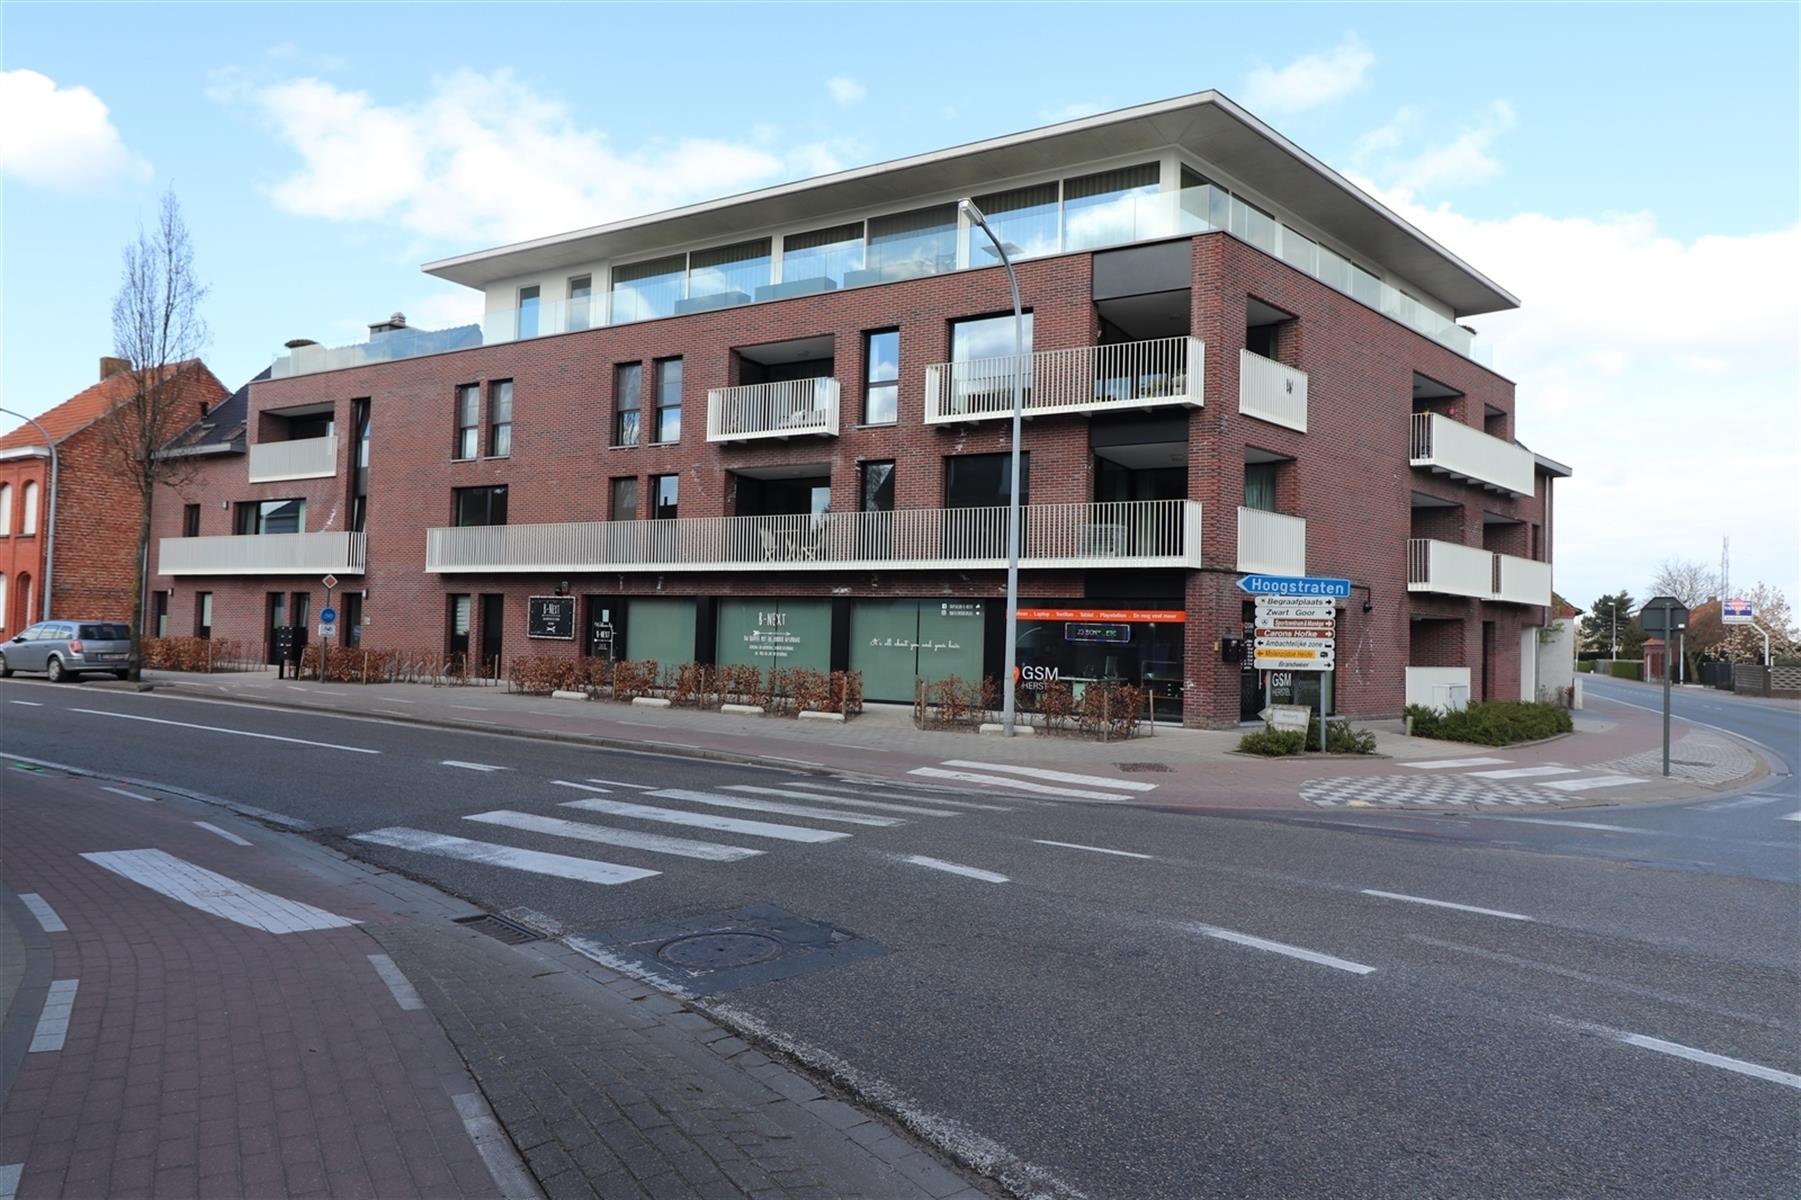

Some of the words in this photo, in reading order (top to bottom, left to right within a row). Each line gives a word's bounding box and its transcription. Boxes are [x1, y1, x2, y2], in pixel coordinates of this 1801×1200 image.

[1252, 578, 1344, 595] Hoogstraten
[1267, 598, 1323, 606] Begraafplaats
[758, 611, 786, 626] B-NEXT
[1294, 630, 1318, 638] Hofke
[894, 638, 909, 647] about
[1265, 640, 1306, 648] Ambachtelijke
[1022, 665, 1059, 681] GSM
[1272, 672, 1292, 687] GSM
